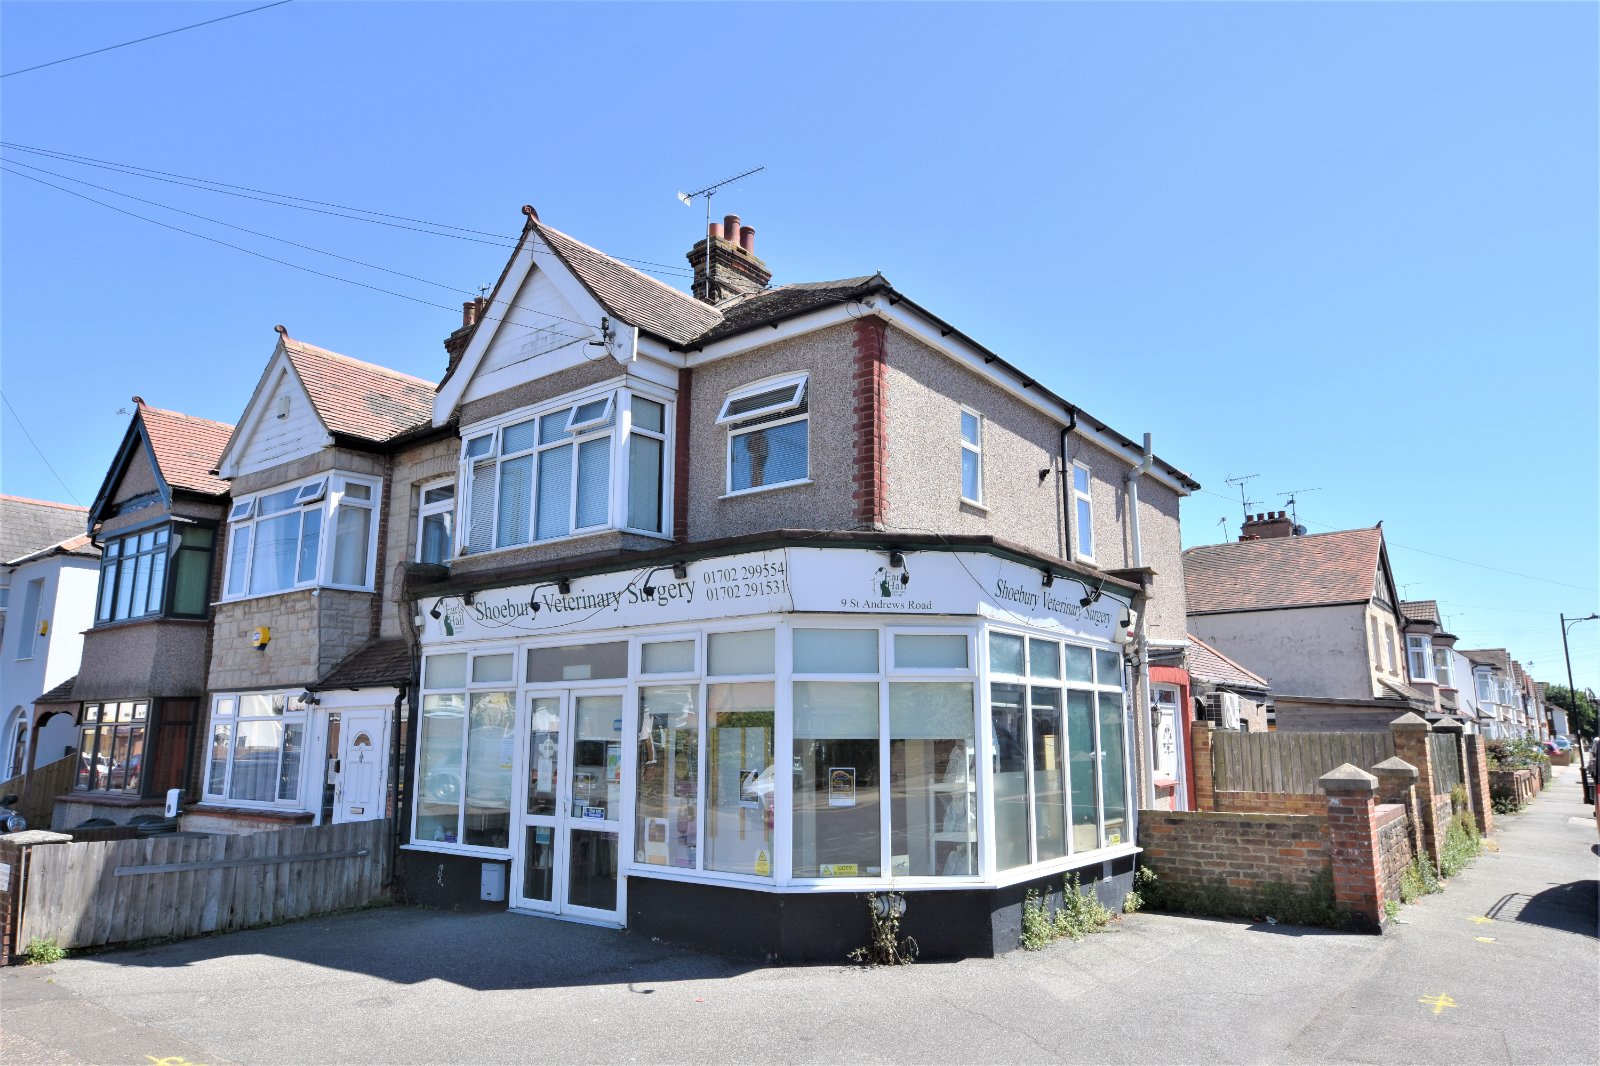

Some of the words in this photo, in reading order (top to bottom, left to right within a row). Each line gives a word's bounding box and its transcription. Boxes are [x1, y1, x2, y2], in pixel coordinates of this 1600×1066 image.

[703, 568, 738, 584] 01702
[741, 562, 785, 579] 299554
[885, 571, 905, 581] Ear
[475, 598, 542, 621] Shoebury
[542, 589, 622, 613] Veterinary
[628, 581, 696, 606] Surgery
[706, 585, 741, 601] 01702
[745, 580, 786, 597] 291531
[841, 598, 848, 608] 9
[850, 598, 860, 608] St
[863, 599, 906, 609] Andrews
[908, 600, 932, 610] Road
[994, 578, 1040, 611] Shoebury
[1042, 591, 1083, 621] Veterinary
[1084, 605, 1113, 628] Surgery
